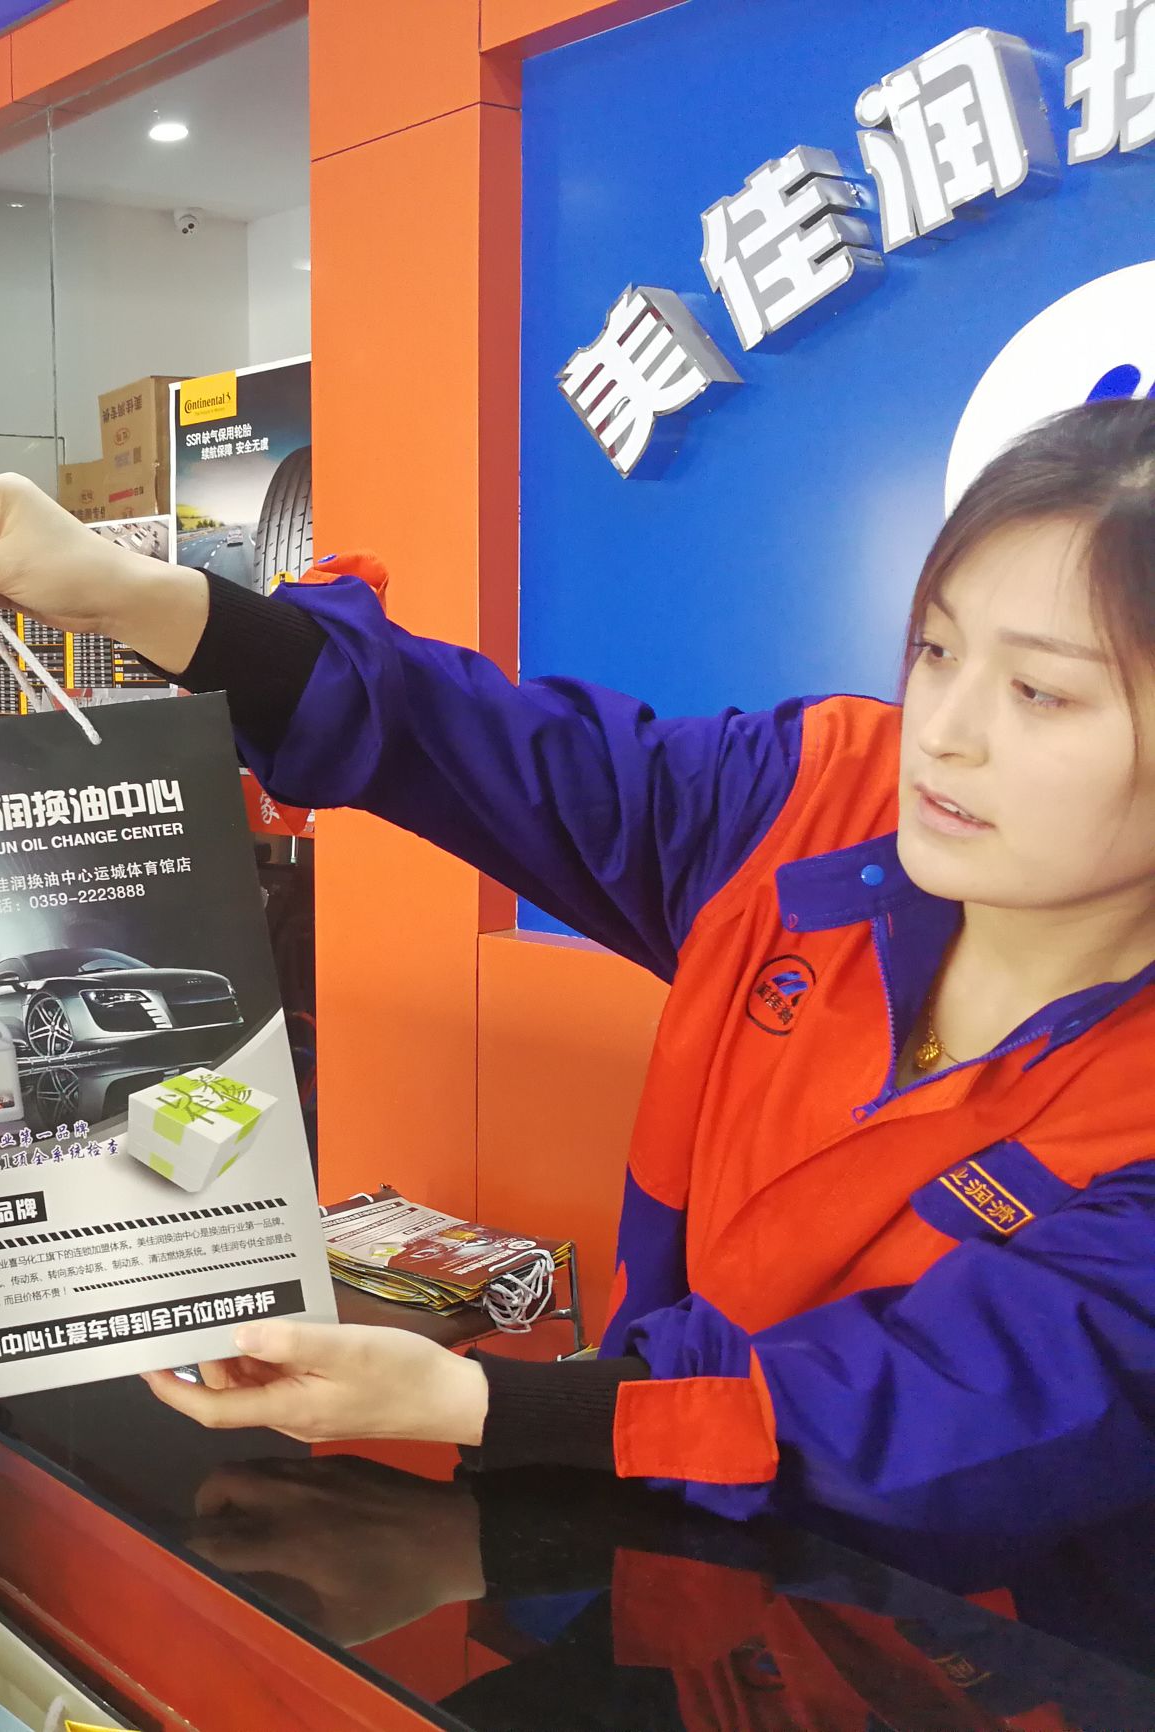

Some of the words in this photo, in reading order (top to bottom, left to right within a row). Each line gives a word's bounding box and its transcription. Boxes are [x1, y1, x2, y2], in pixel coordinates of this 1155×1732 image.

[184, 393, 225, 413] Continental
[21, 837, 48, 852] OIL
[51, 829, 119, 849] CHANGE
[121, 822, 184, 842] CENTER
